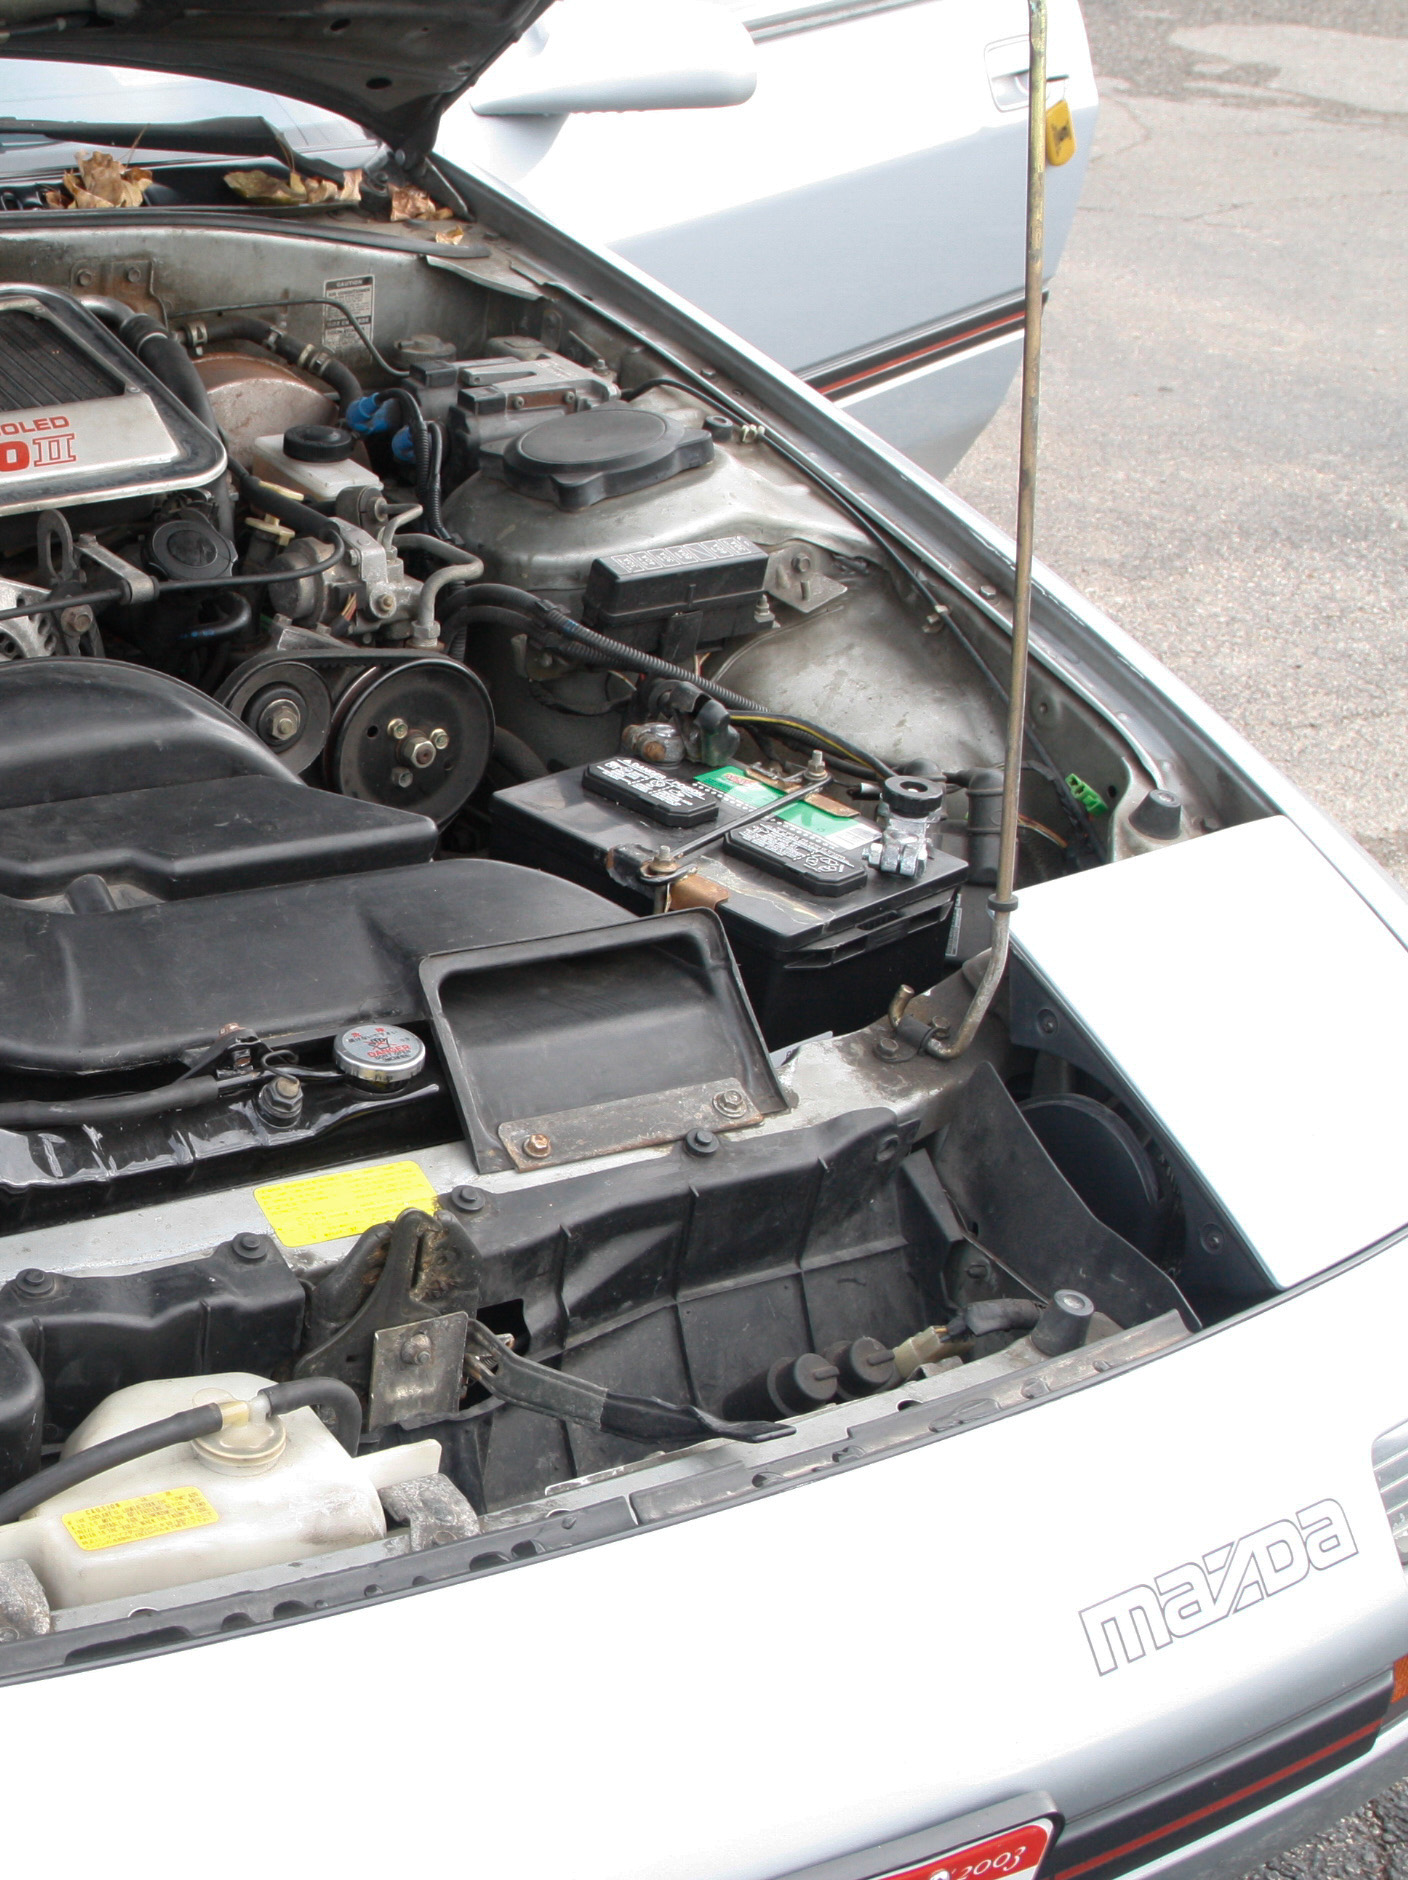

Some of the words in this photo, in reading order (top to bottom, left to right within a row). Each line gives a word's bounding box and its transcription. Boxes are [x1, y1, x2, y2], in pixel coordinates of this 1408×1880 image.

[32, 432, 78, 467] II
[367, 1044, 411, 1059] DANGER
[1078, 1498, 1359, 1677] mazda
